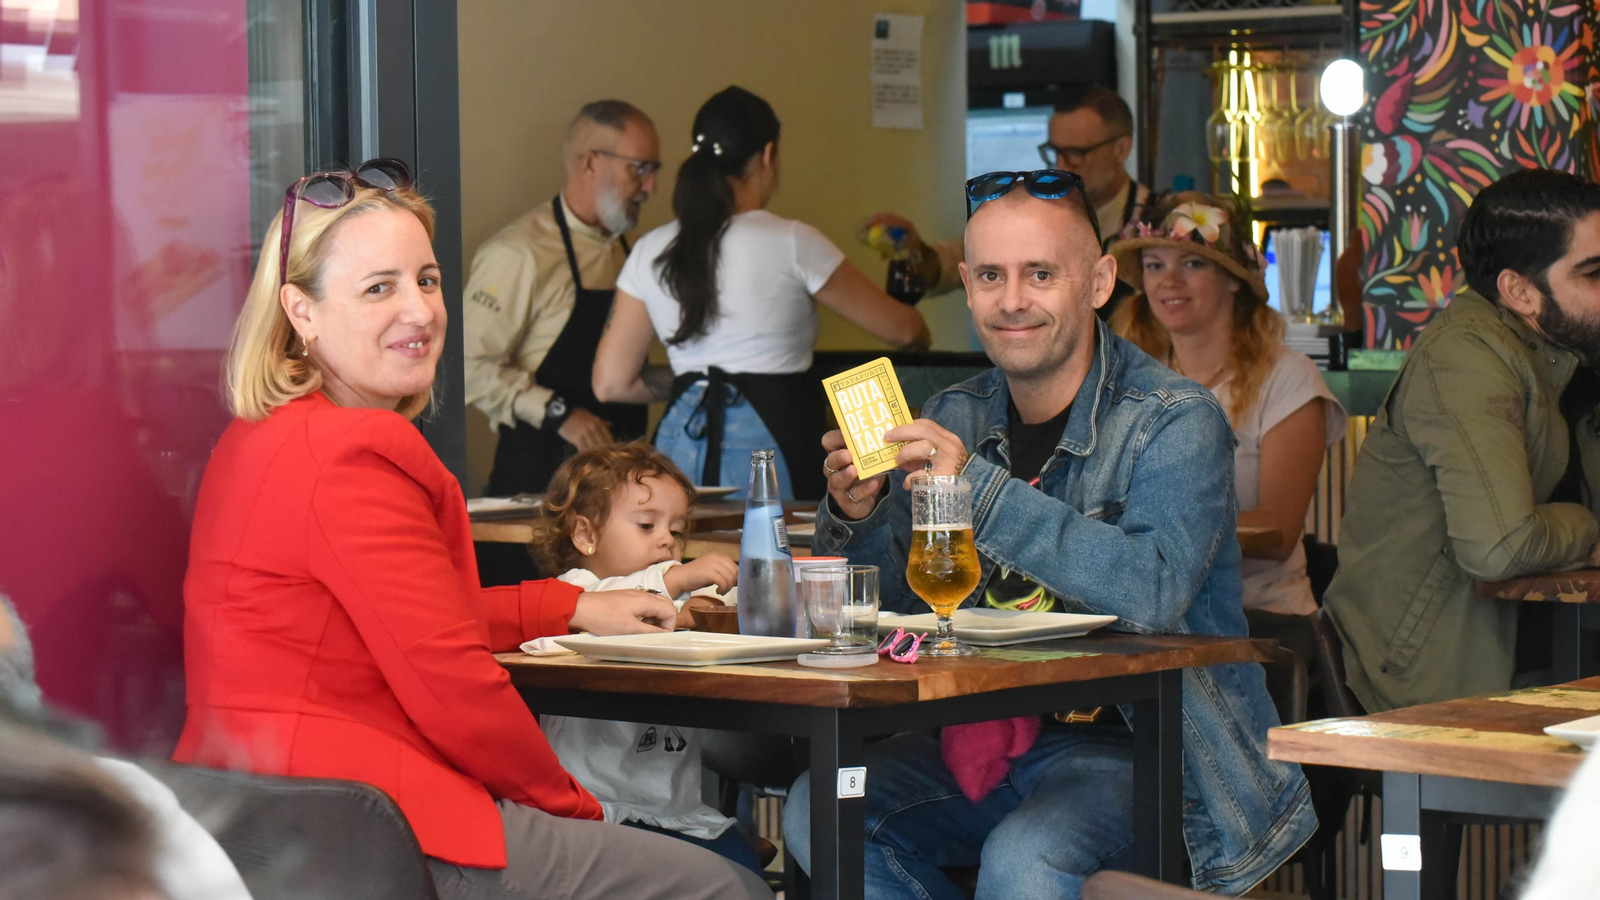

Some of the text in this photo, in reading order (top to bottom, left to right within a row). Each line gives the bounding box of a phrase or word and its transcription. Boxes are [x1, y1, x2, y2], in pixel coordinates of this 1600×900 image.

[836, 379, 884, 414] RUTA
[845, 409, 870, 434] DE
[868, 402, 892, 425] LA
[850, 776, 856, 789] 8
[1400, 846, 1408, 859] 9
